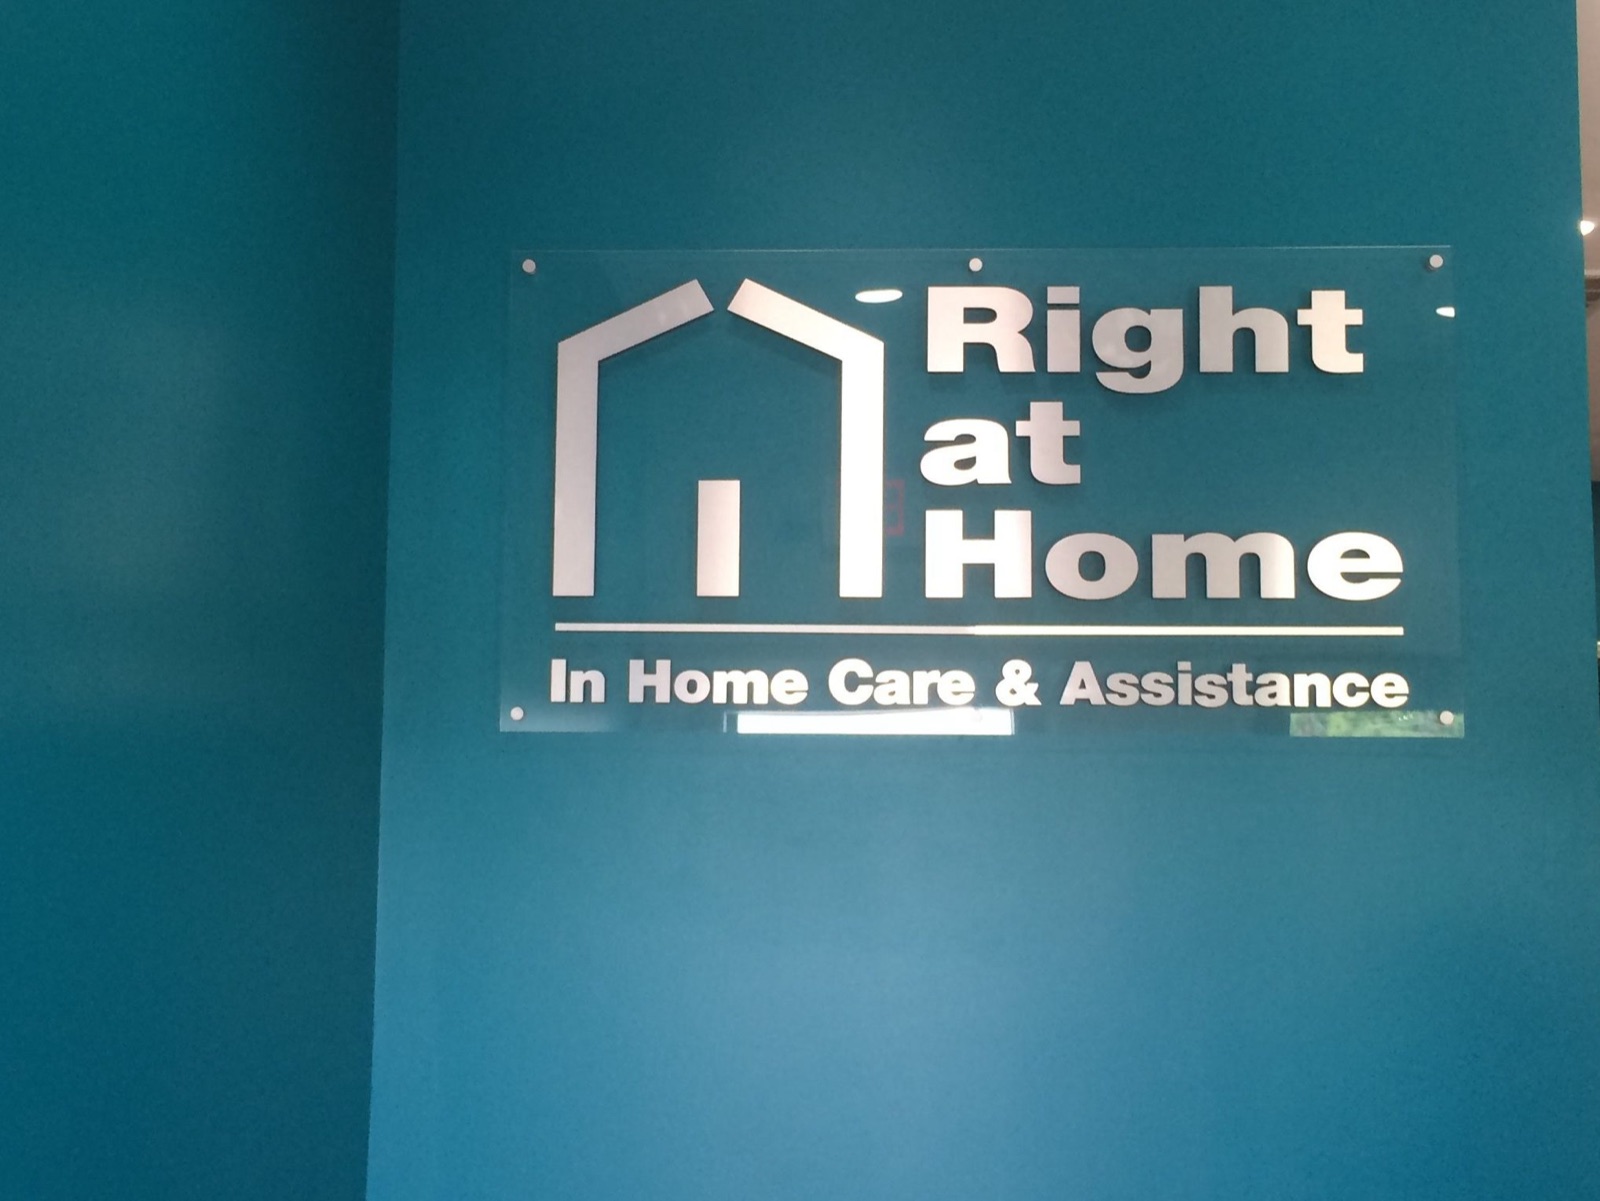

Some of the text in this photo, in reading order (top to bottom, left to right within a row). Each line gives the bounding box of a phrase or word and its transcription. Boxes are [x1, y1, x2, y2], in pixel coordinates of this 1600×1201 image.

[926, 285, 1365, 394] Right
[920, 401, 1081, 486] at
[925, 508, 1404, 601] Home
[550, 657, 1410, 708] In Home Care & Assistance
